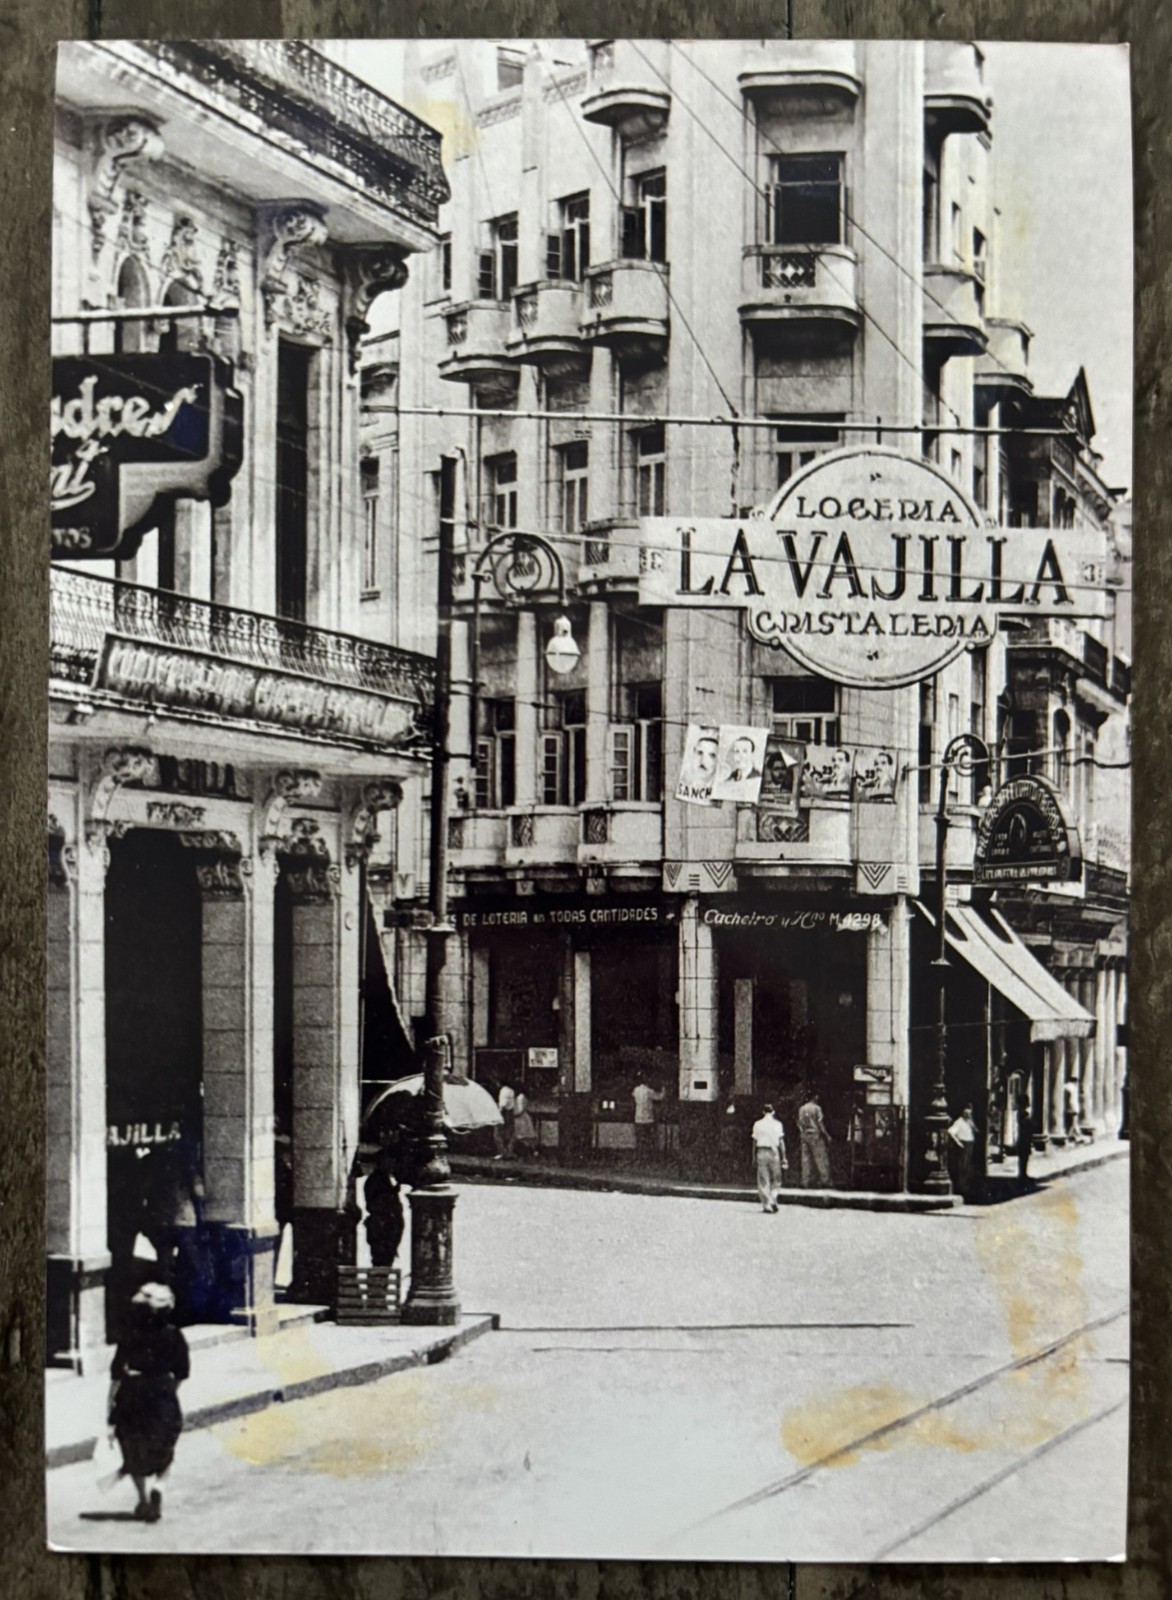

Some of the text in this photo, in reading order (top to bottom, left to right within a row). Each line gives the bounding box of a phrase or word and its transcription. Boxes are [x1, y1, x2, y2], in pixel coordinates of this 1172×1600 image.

[796, 496, 962, 524] LOCERIA
[676, 526, 1075, 606] LA VAJILLA
[755, 610, 992, 639] CRISTALERIA
[482, 911, 528, 926] LOTERIA
[549, 909, 587, 924] TODAS
[589, 907, 658, 923] CANTIDADES
